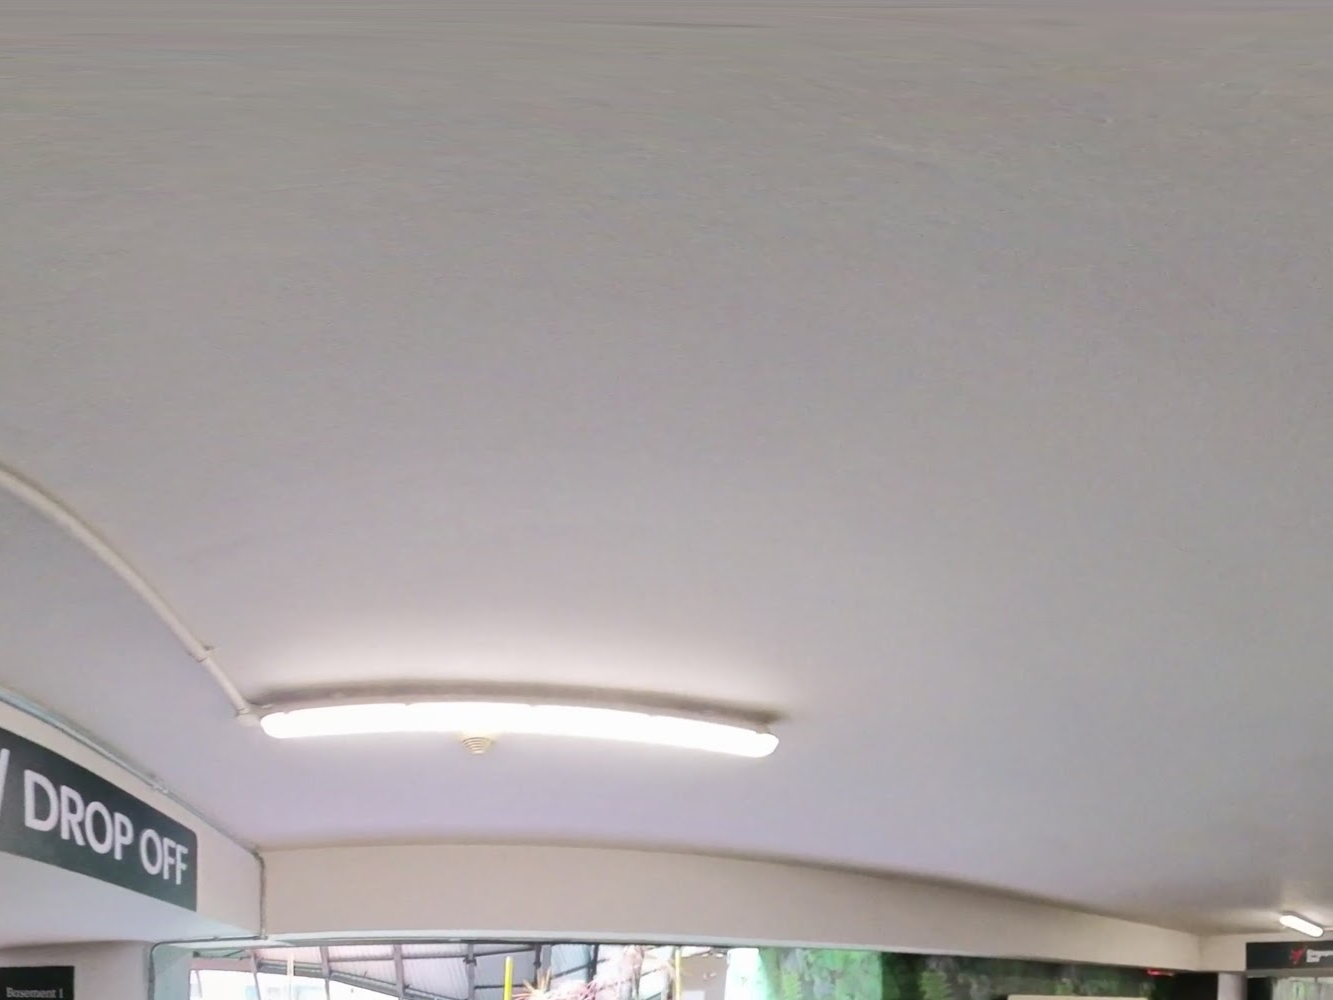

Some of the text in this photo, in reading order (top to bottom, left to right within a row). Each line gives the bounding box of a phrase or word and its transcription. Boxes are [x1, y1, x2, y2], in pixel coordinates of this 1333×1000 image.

[24, 768, 133, 861] DROP
[139, 827, 188, 885] OFF
[6, 987, 64, 999] Basement 1
